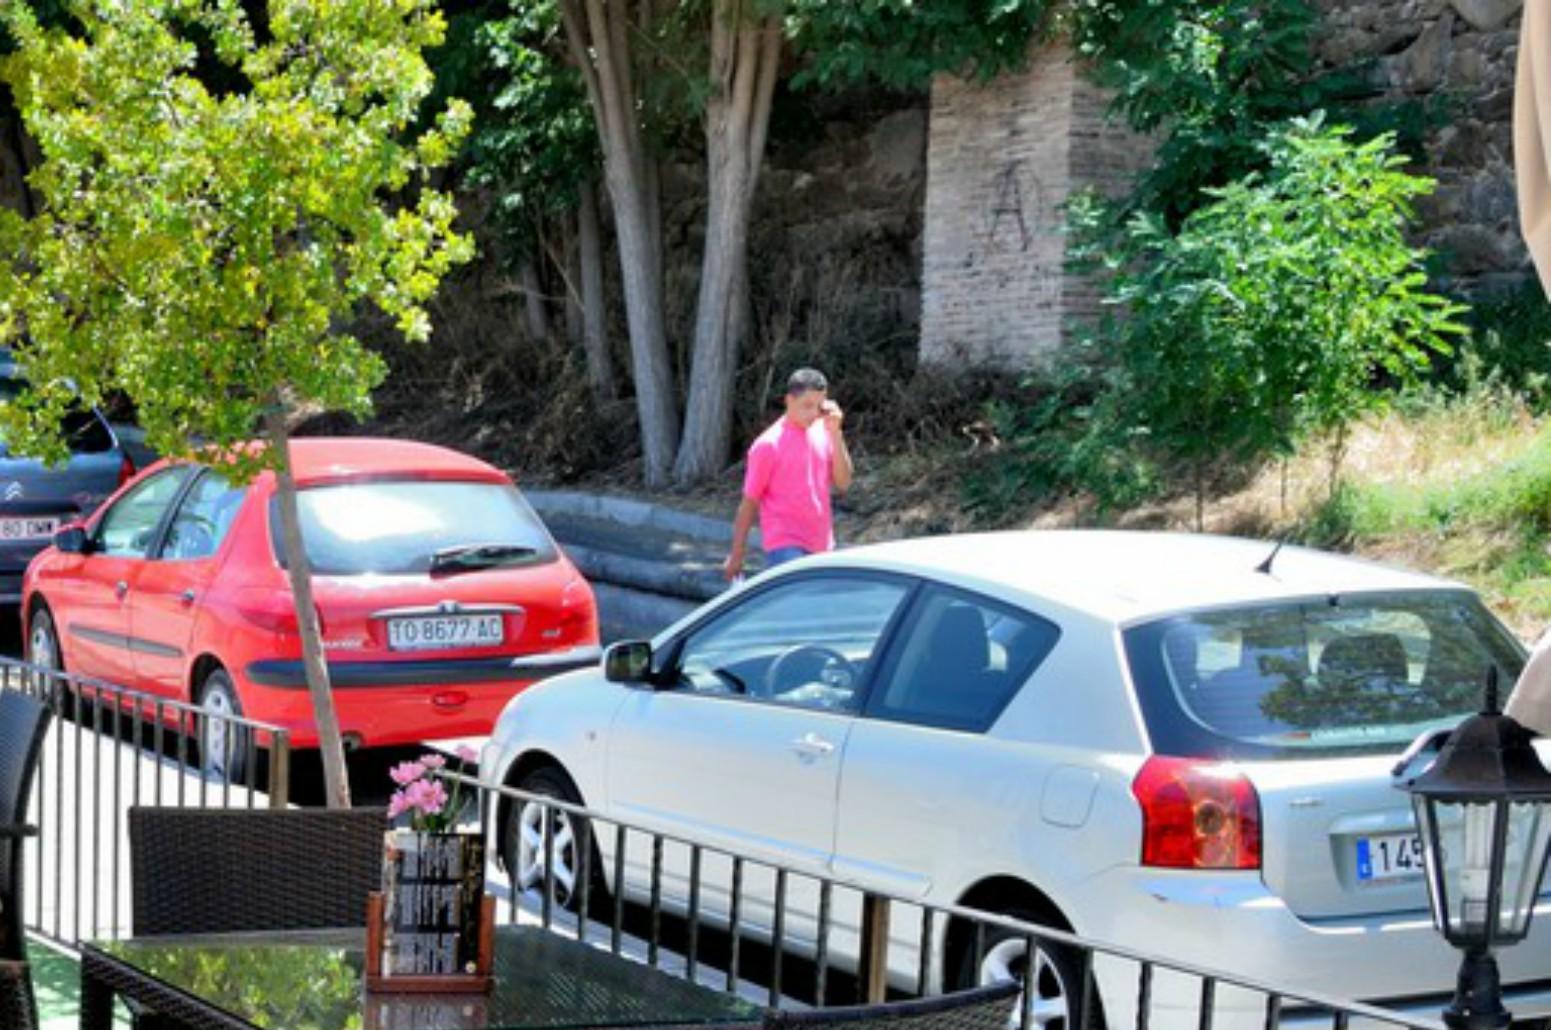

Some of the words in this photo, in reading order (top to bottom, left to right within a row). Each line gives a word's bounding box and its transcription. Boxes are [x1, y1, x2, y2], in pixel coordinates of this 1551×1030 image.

[391, 619, 417, 643] TO
[423, 618, 471, 641] 8677
[478, 617, 501, 638] AC
